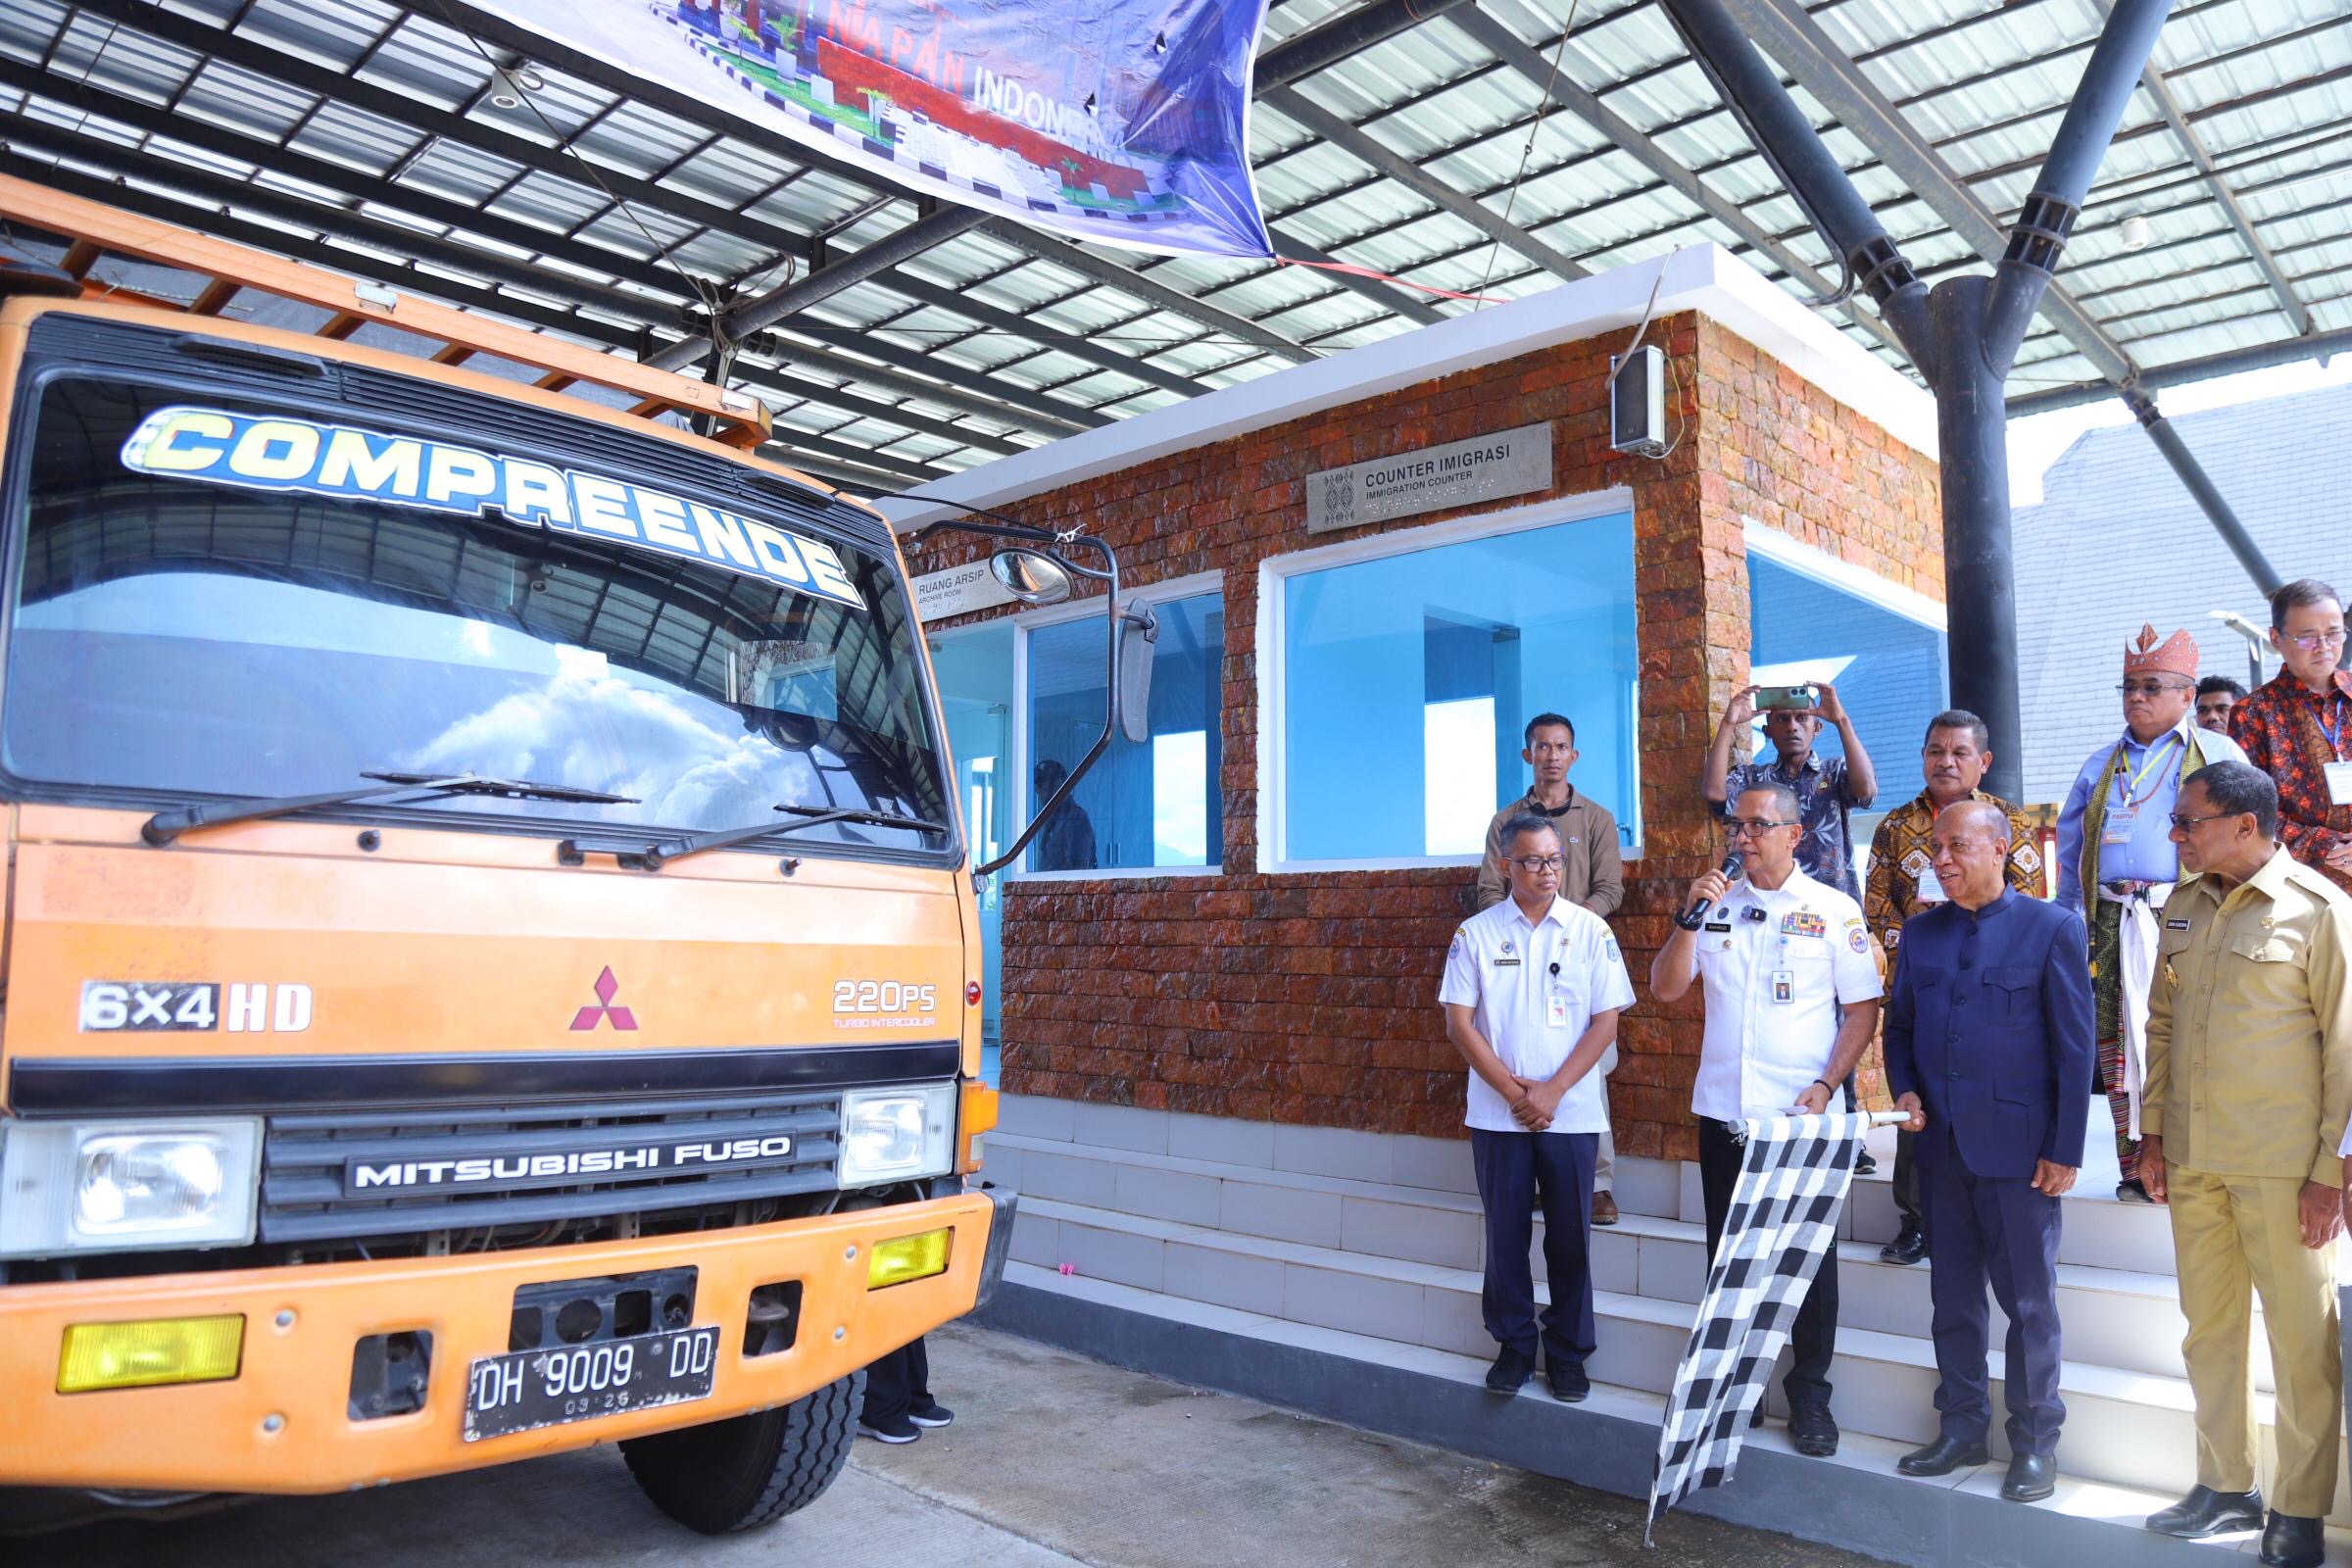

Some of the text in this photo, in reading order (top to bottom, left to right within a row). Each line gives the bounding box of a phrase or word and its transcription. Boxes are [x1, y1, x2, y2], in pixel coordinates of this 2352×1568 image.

[1365, 444, 1510, 488] COUNTER IMIGRASI
[1366, 470, 1473, 500] IMMIGRATION COUNTER
[145, 414, 854, 596] COMPREENDE
[918, 569, 984, 595] RUANG ARSIP
[918, 589, 961, 604] ARCHIVE ROOM
[226, 983, 313, 1032] HD
[833, 980, 936, 1012] 220PS
[833, 1017, 935, 1028] TURBO INTERCOOLER
[355, 1137, 791, 1188] MITSUBISHI FUSO
[477, 1332, 712, 1411] DH 9009 DD
